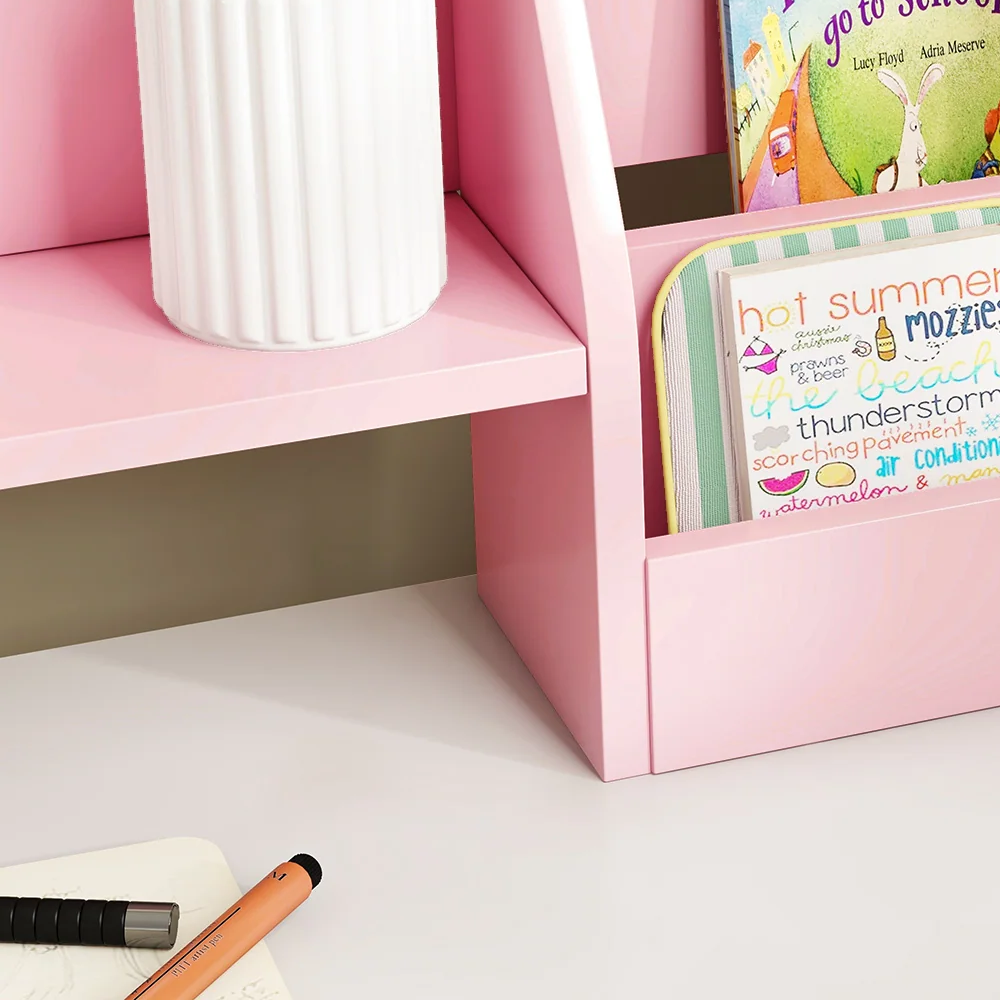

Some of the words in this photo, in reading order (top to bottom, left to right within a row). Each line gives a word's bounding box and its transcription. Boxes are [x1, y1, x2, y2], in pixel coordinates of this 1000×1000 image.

[823, 9, 852, 68] go
[853, 54, 876, 71] Lucy
[878, 49, 905, 67] Floyd
[920, 43, 945, 60] Adria
[948, 37, 986, 57] Meserve
[738, 291, 807, 336] hot
[790, 354, 846, 377] prawns
[797, 372, 809, 385] &
[813, 367, 849, 383] beer
[744, 375, 838, 419] the
[863, 416, 968, 459] pavement
[875, 454, 901, 478] air
[916, 475, 929, 489] &
[208, 933, 223, 947] pen
